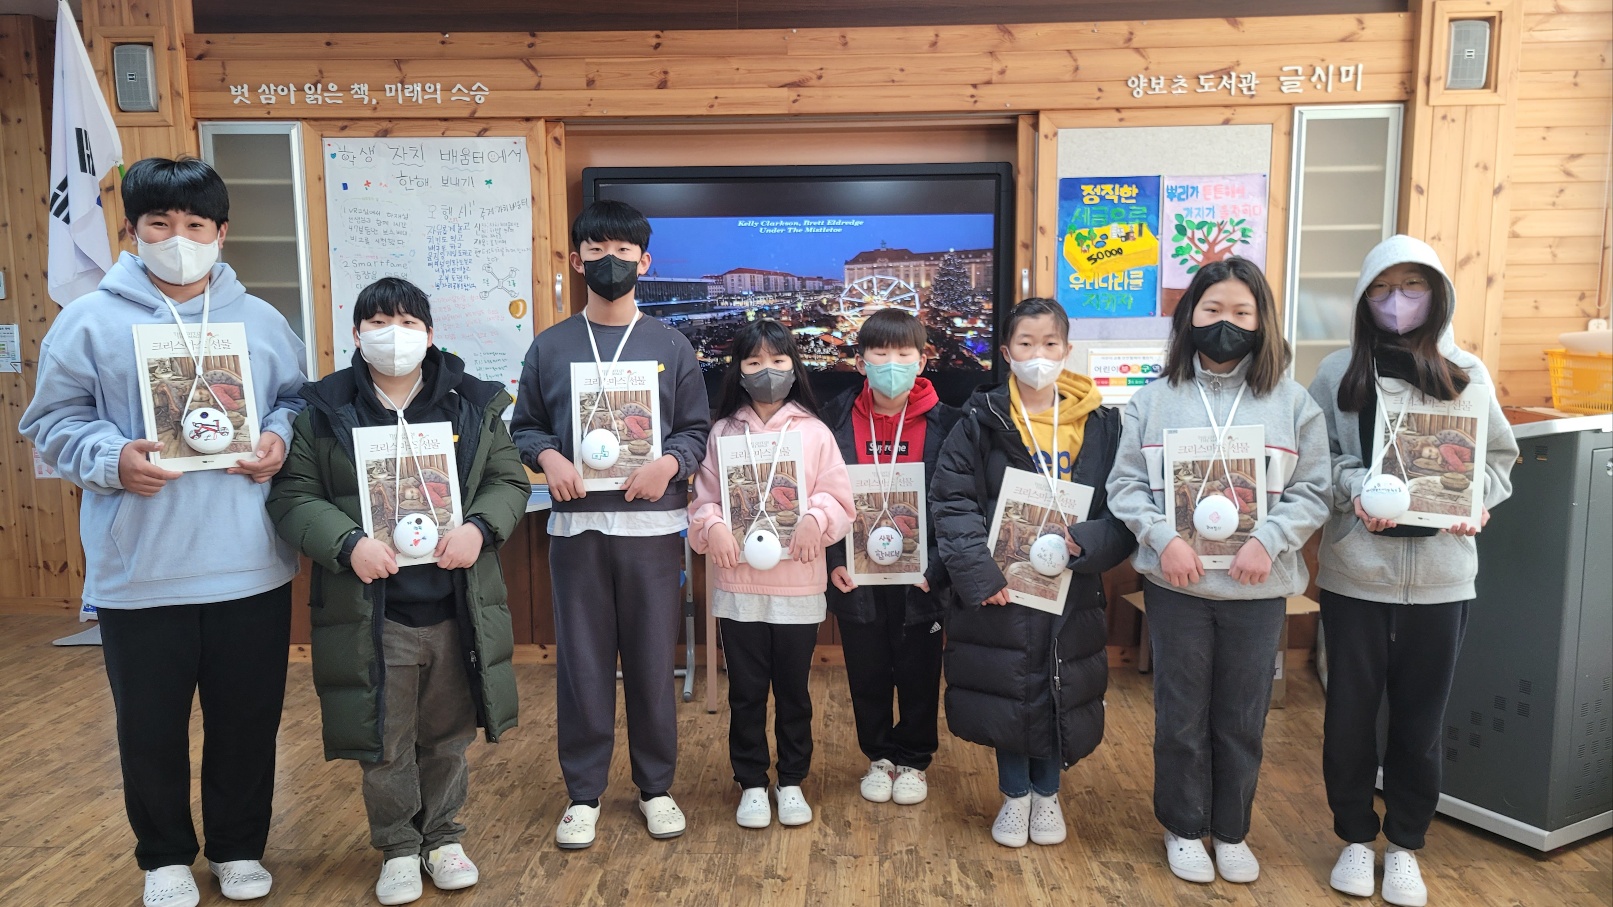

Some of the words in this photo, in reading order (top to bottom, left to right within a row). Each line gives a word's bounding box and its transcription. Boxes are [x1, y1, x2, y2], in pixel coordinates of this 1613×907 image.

[1127, 74, 1189, 98] 양보초
[1195, 71, 1260, 96] 도서관
[230, 83, 251, 105] 벗
[257, 83, 297, 105] 삼아
[303, 83, 344, 105] 읽은
[350, 83, 377, 105] 책,
[384, 83, 442, 104] 미래의
[451, 82, 490, 104] 스승
[338, 144, 376, 166] 학생
[386, 144, 425, 162] 자치
[395, 170, 430, 191] 한해
[441, 175, 475, 188] 보내기!
[1080, 184, 1139, 205] 정직한
[1166, 184, 1200, 202] 뿌리가
[1072, 205, 1148, 226] 세금으로
[1183, 206, 1216, 220] 가지가
[738, 220, 759, 228] Kelly
[761, 219, 802, 227] Clarkson,
[827, 219, 864, 227] Eldredge
[211, 339, 232, 350] 선물
[584, 376, 627, 387] 크리마스
[629, 375, 646, 386] 선물
[1451, 399, 1472, 411] 선물
[421, 438, 440, 450] 선물
[868, 443, 906, 453] Supree
[1230, 442, 1250, 454] 선물
[730, 449, 772, 460] 크리마스
[899, 477, 914, 487] 선물
[1060, 496, 1077, 510] 선물
